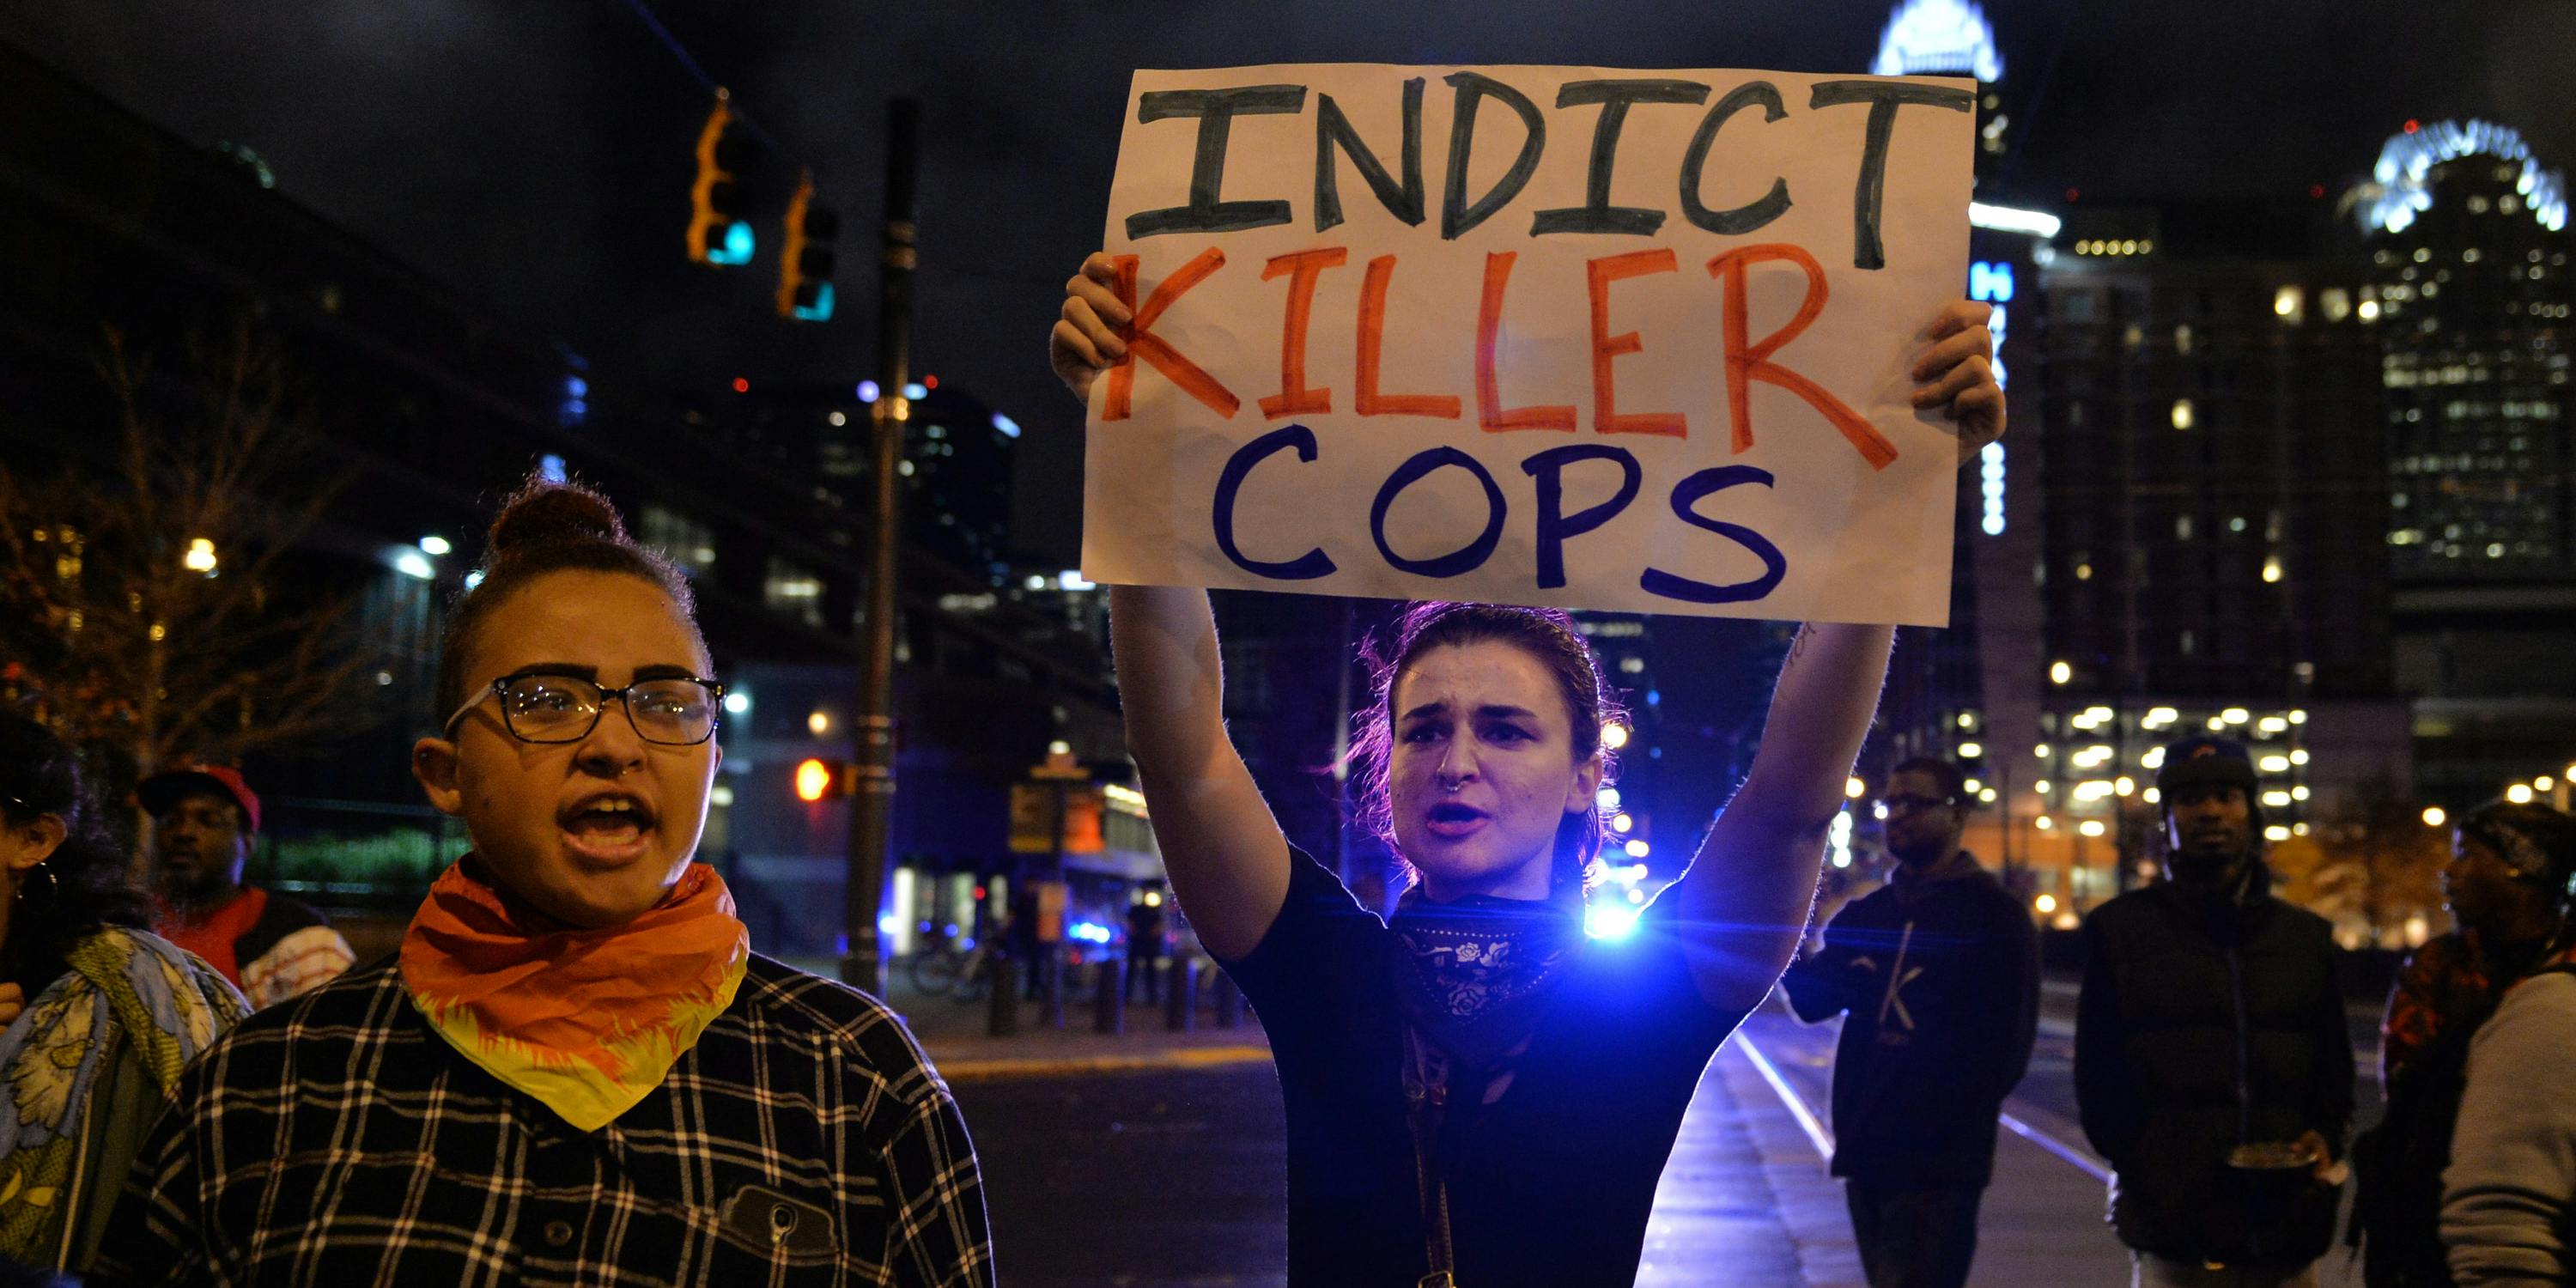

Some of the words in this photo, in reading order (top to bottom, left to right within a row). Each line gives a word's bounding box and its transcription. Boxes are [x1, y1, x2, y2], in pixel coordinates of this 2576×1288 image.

[1126, 71, 1974, 270] INDICT
[1102, 244, 1897, 471] KILLER
[1212, 424, 1786, 604] COPS
